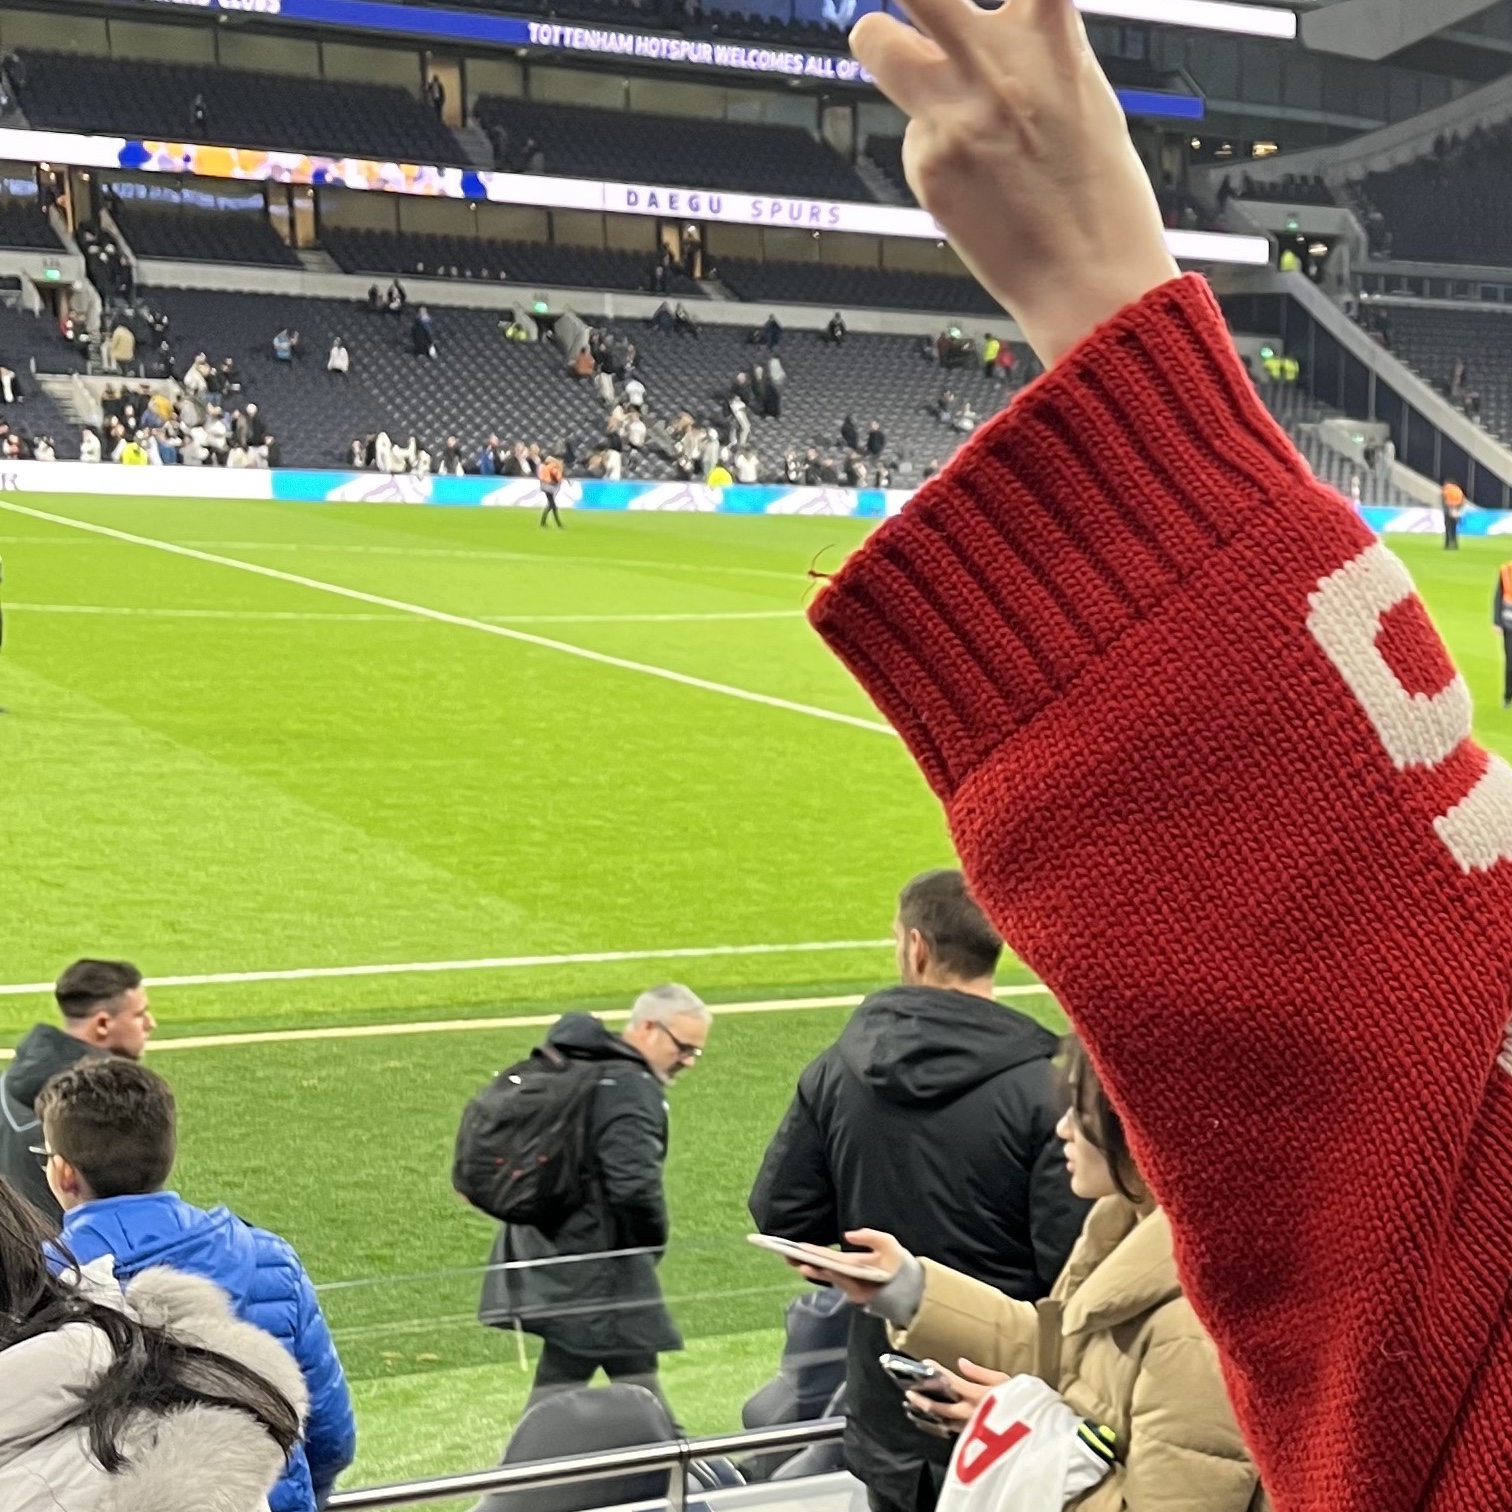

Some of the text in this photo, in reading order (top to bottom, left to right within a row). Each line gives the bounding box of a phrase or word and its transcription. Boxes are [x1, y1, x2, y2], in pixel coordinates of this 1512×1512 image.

[527, 22, 634, 55] TOTTENHAM
[635, 35, 713, 64] HOTSPUR
[714, 45, 804, 75] WELCOMES
[805, 56, 836, 79] ALL
[836, 61, 860, 81] OF
[626, 187, 841, 224] DAEGU SPURS
